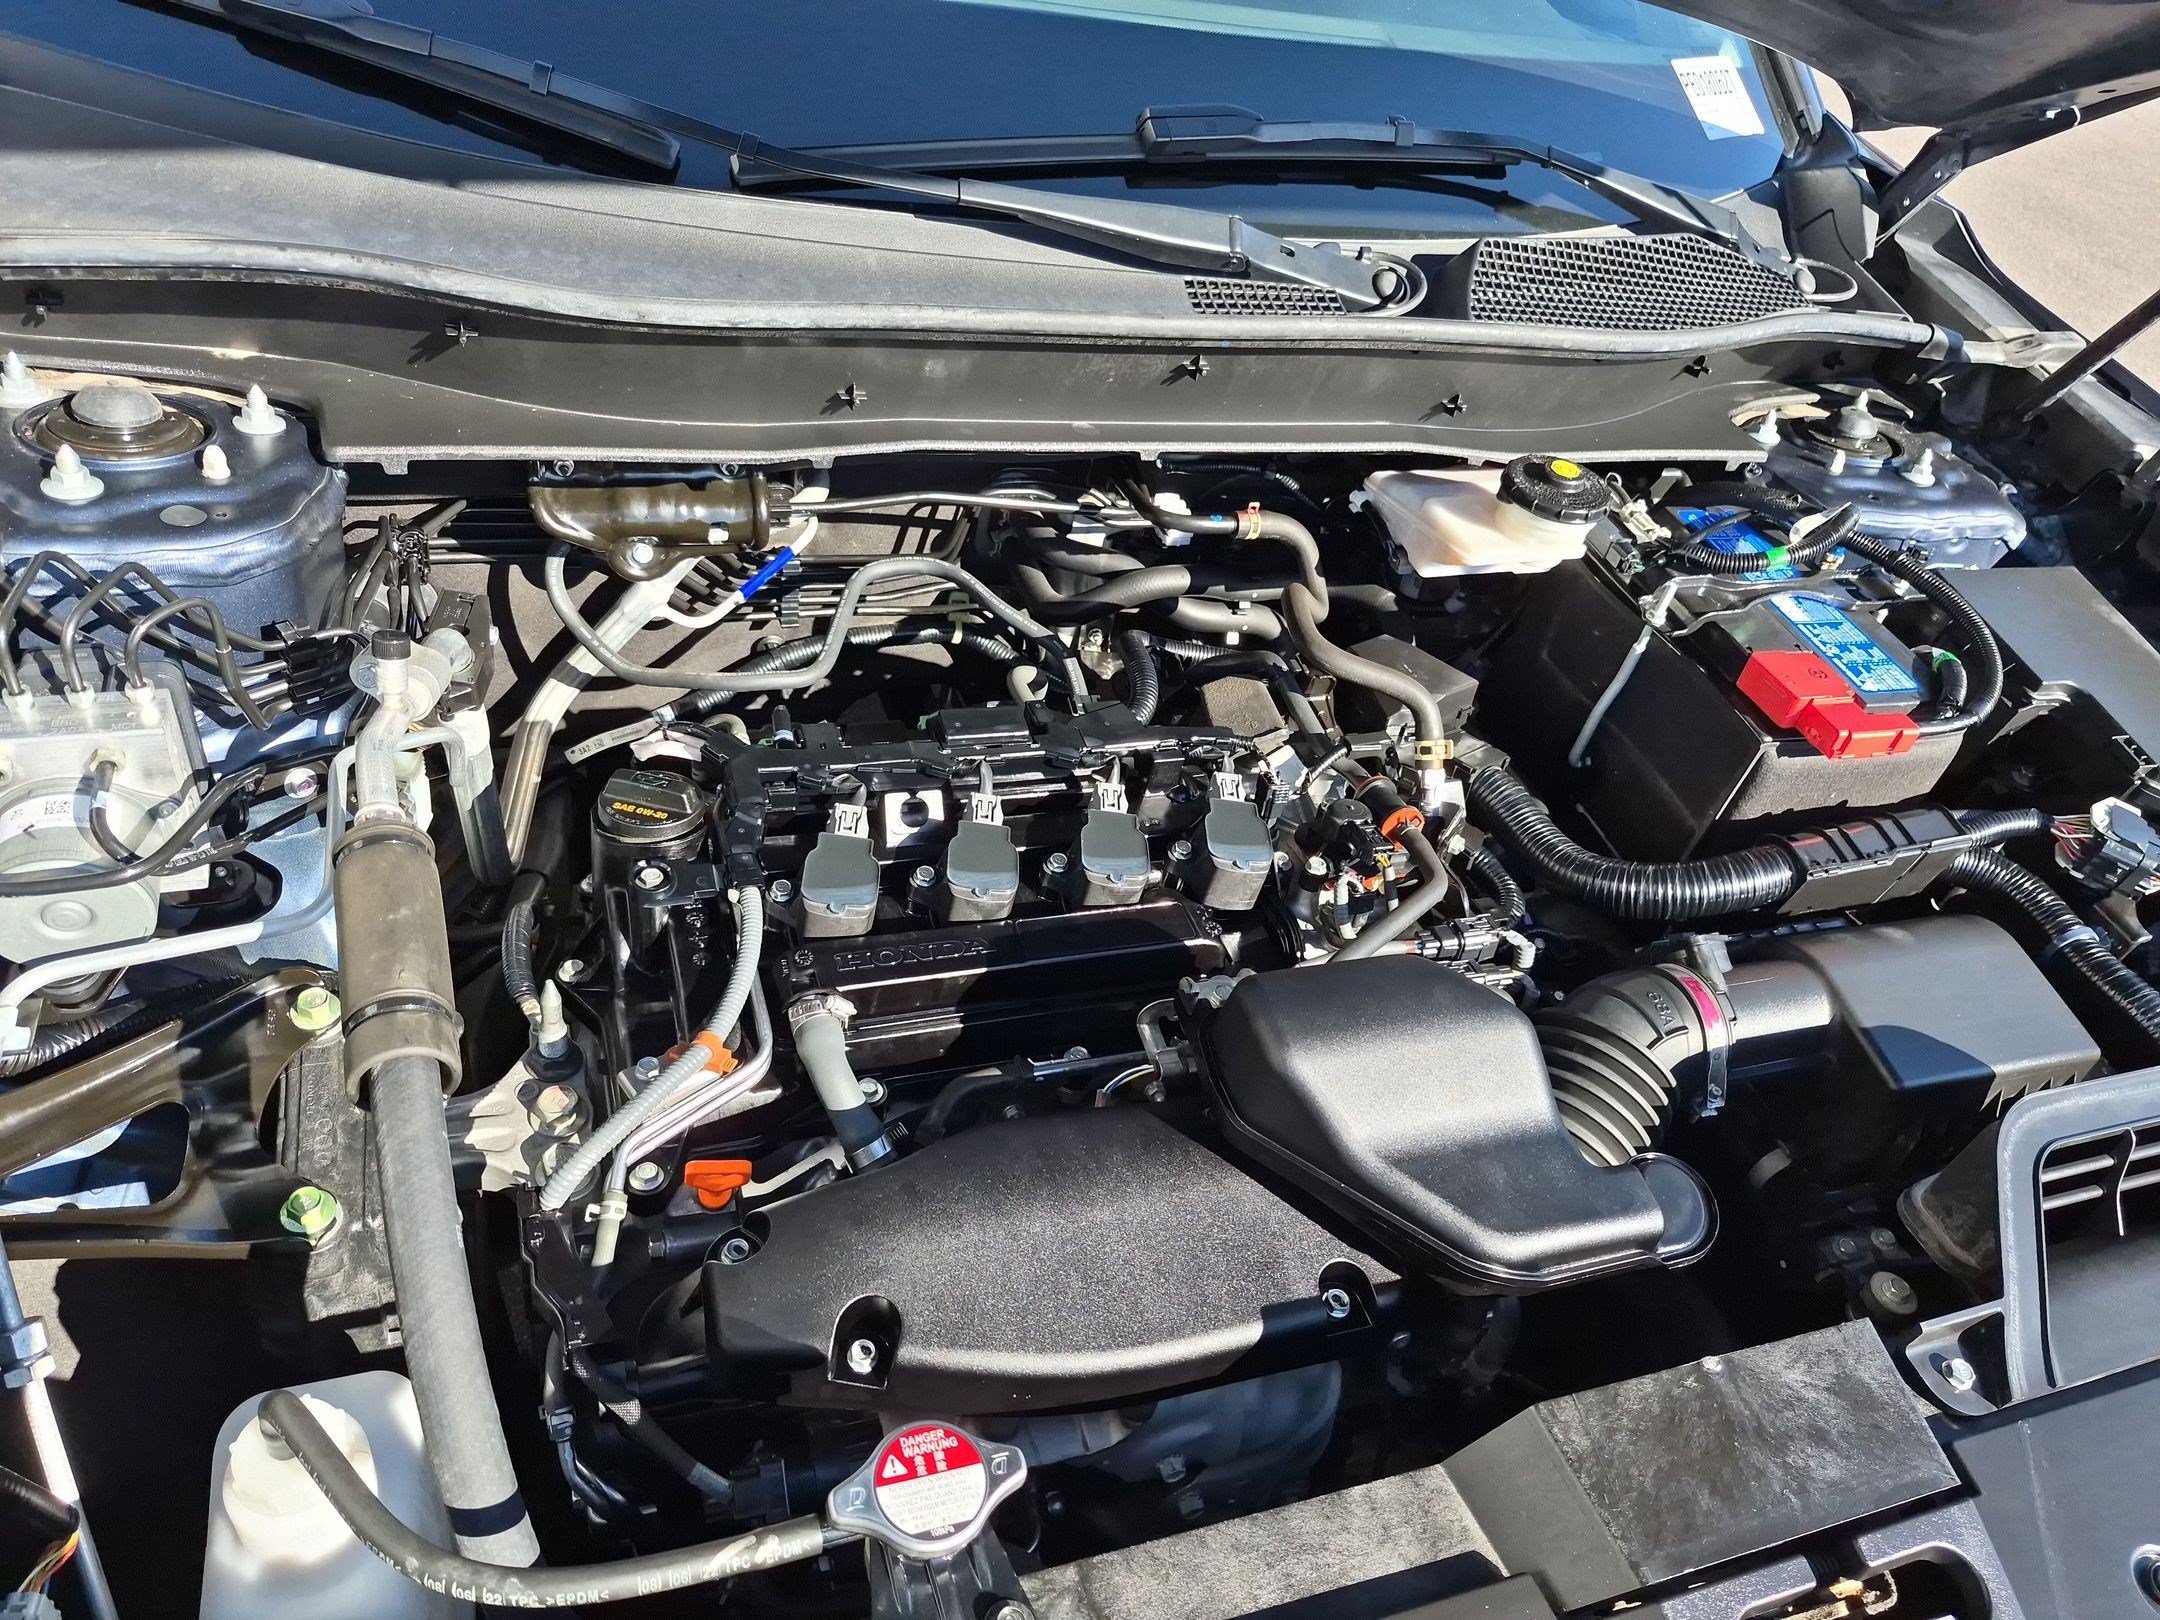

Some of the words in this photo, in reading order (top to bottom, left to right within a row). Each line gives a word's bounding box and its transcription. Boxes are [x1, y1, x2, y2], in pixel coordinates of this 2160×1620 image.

[611, 801, 636, 814] SAE
[635, 806, 669, 820] 0W-20
[833, 936, 997, 972] HONDA
[899, 1428, 946, 1448] DANGER
[901, 1435, 959, 1458] WARNUNG
